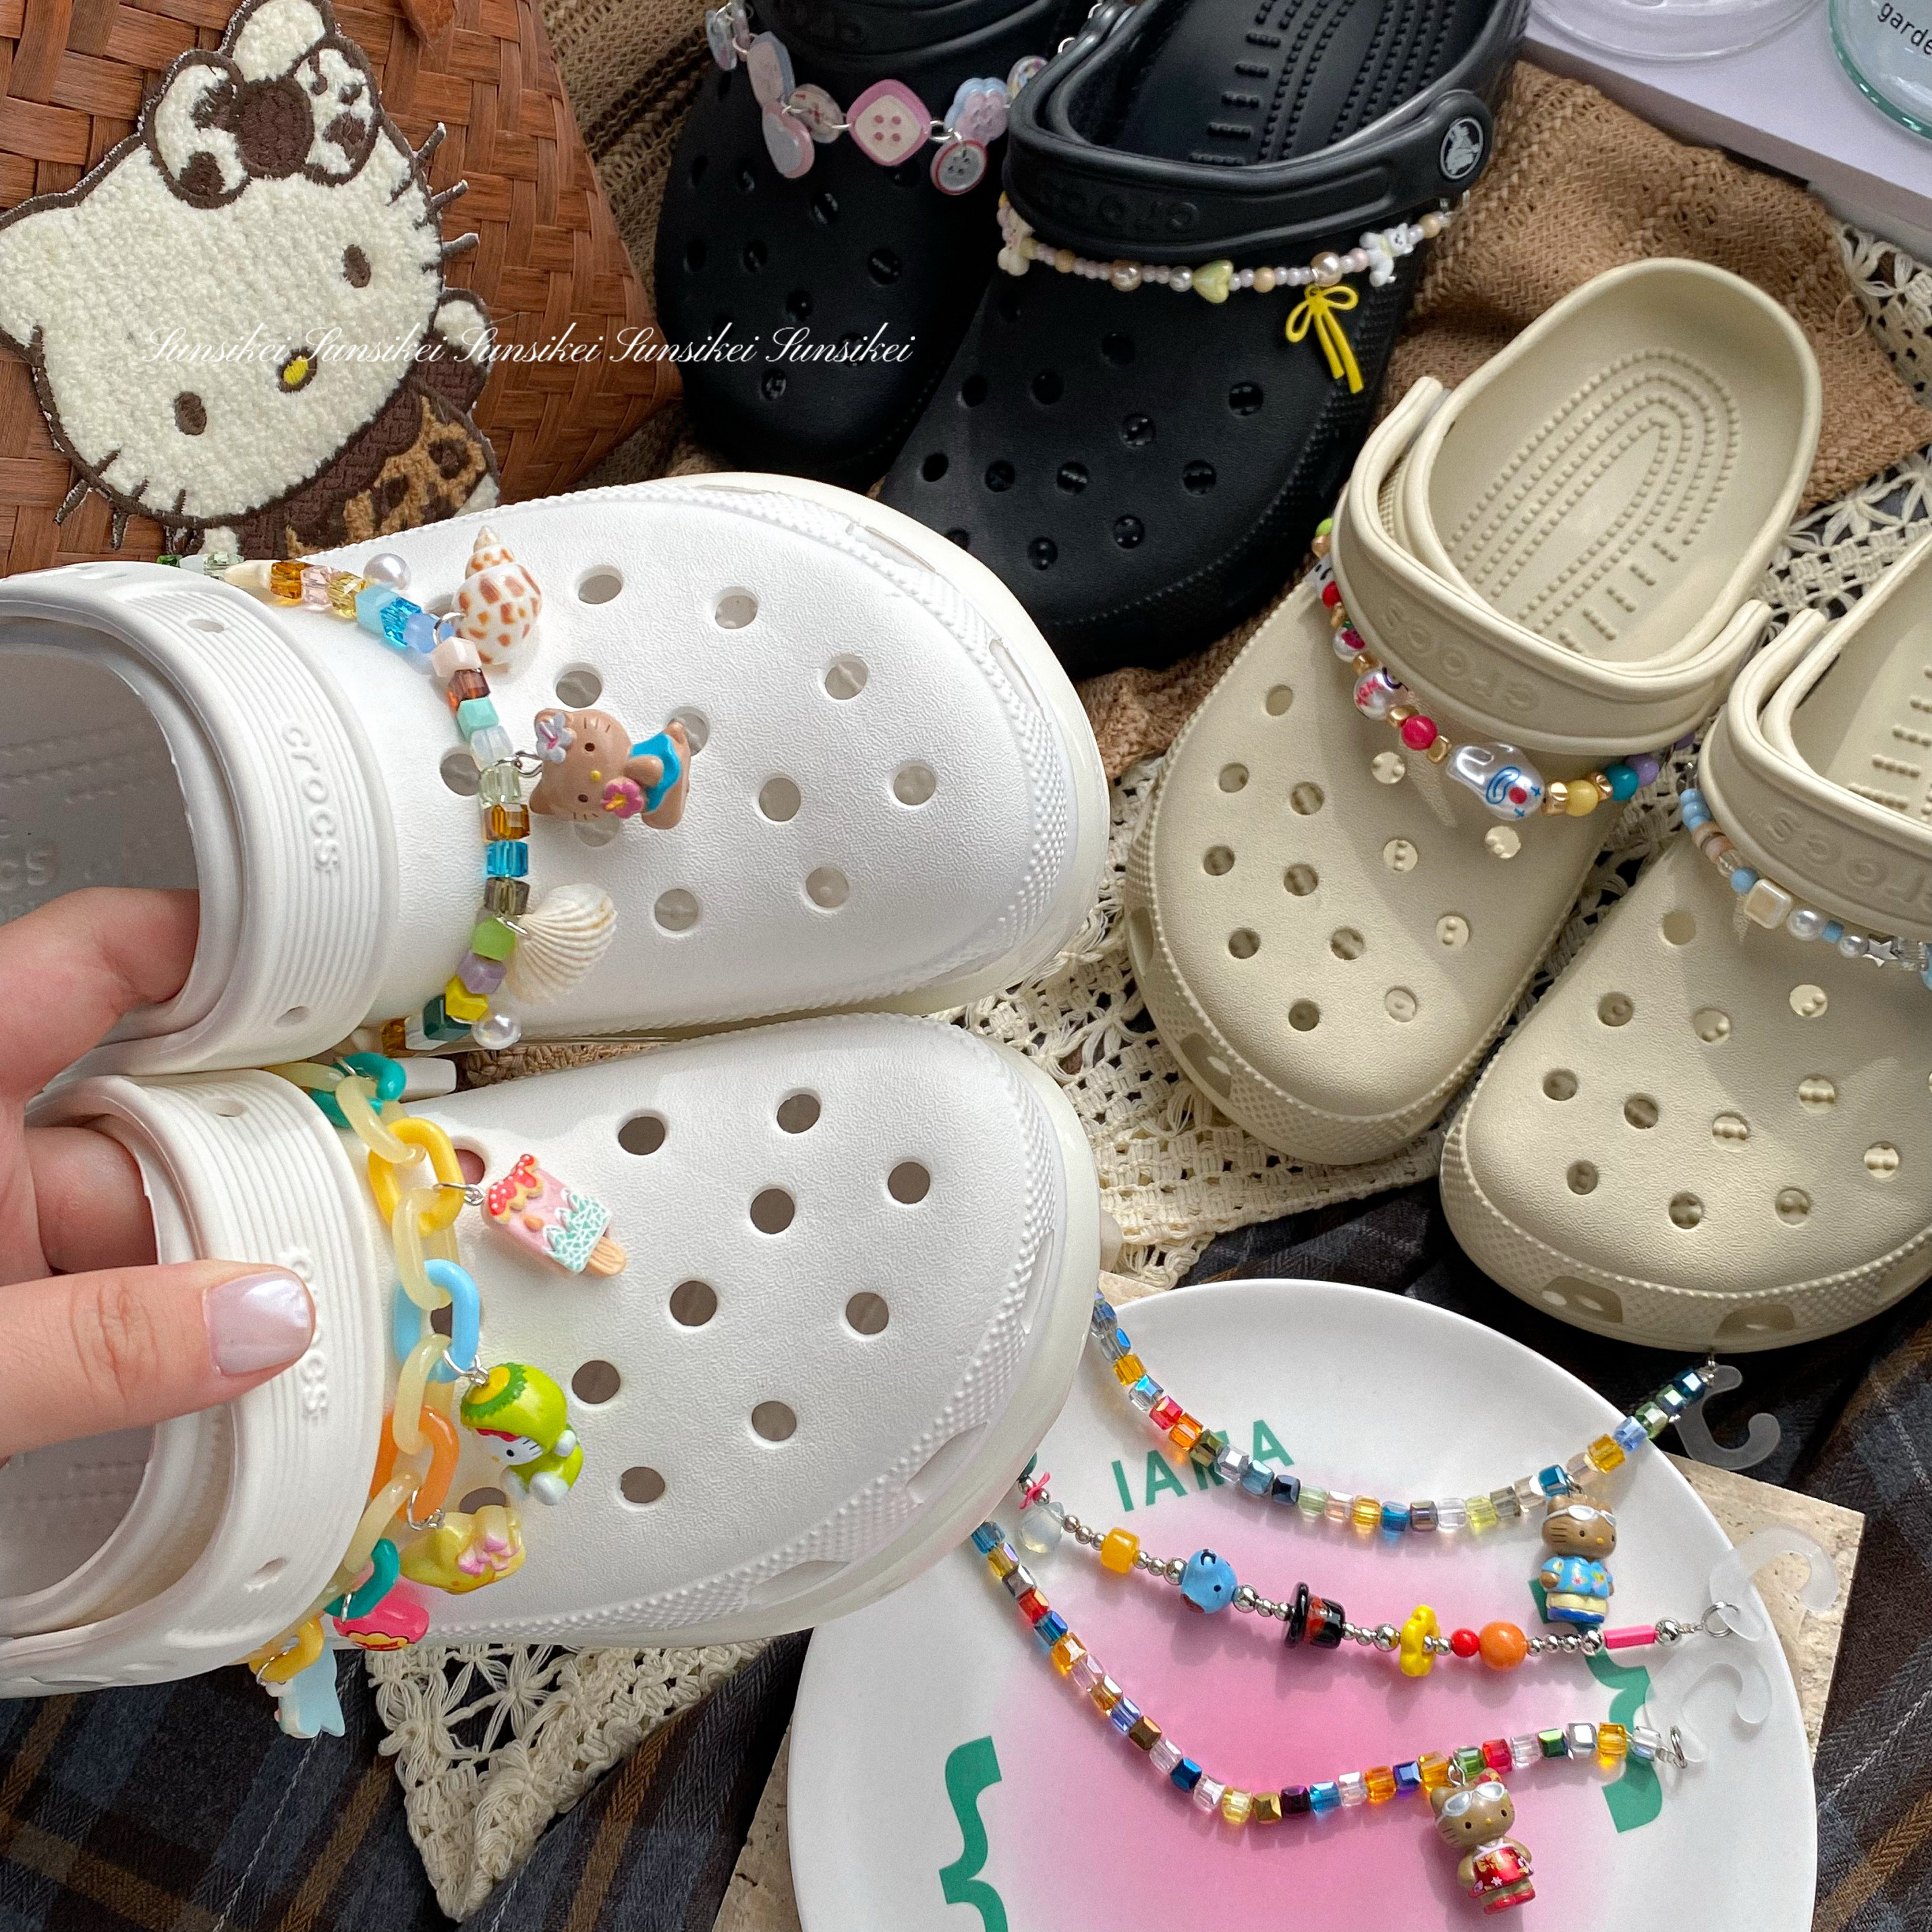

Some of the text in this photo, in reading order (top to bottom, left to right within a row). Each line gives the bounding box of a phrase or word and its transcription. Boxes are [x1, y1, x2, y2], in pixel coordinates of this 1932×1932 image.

[1877, 3, 1932, 55] garde
[1382, 598, 1540, 712] crocs
[281, 721, 338, 867] crocs
